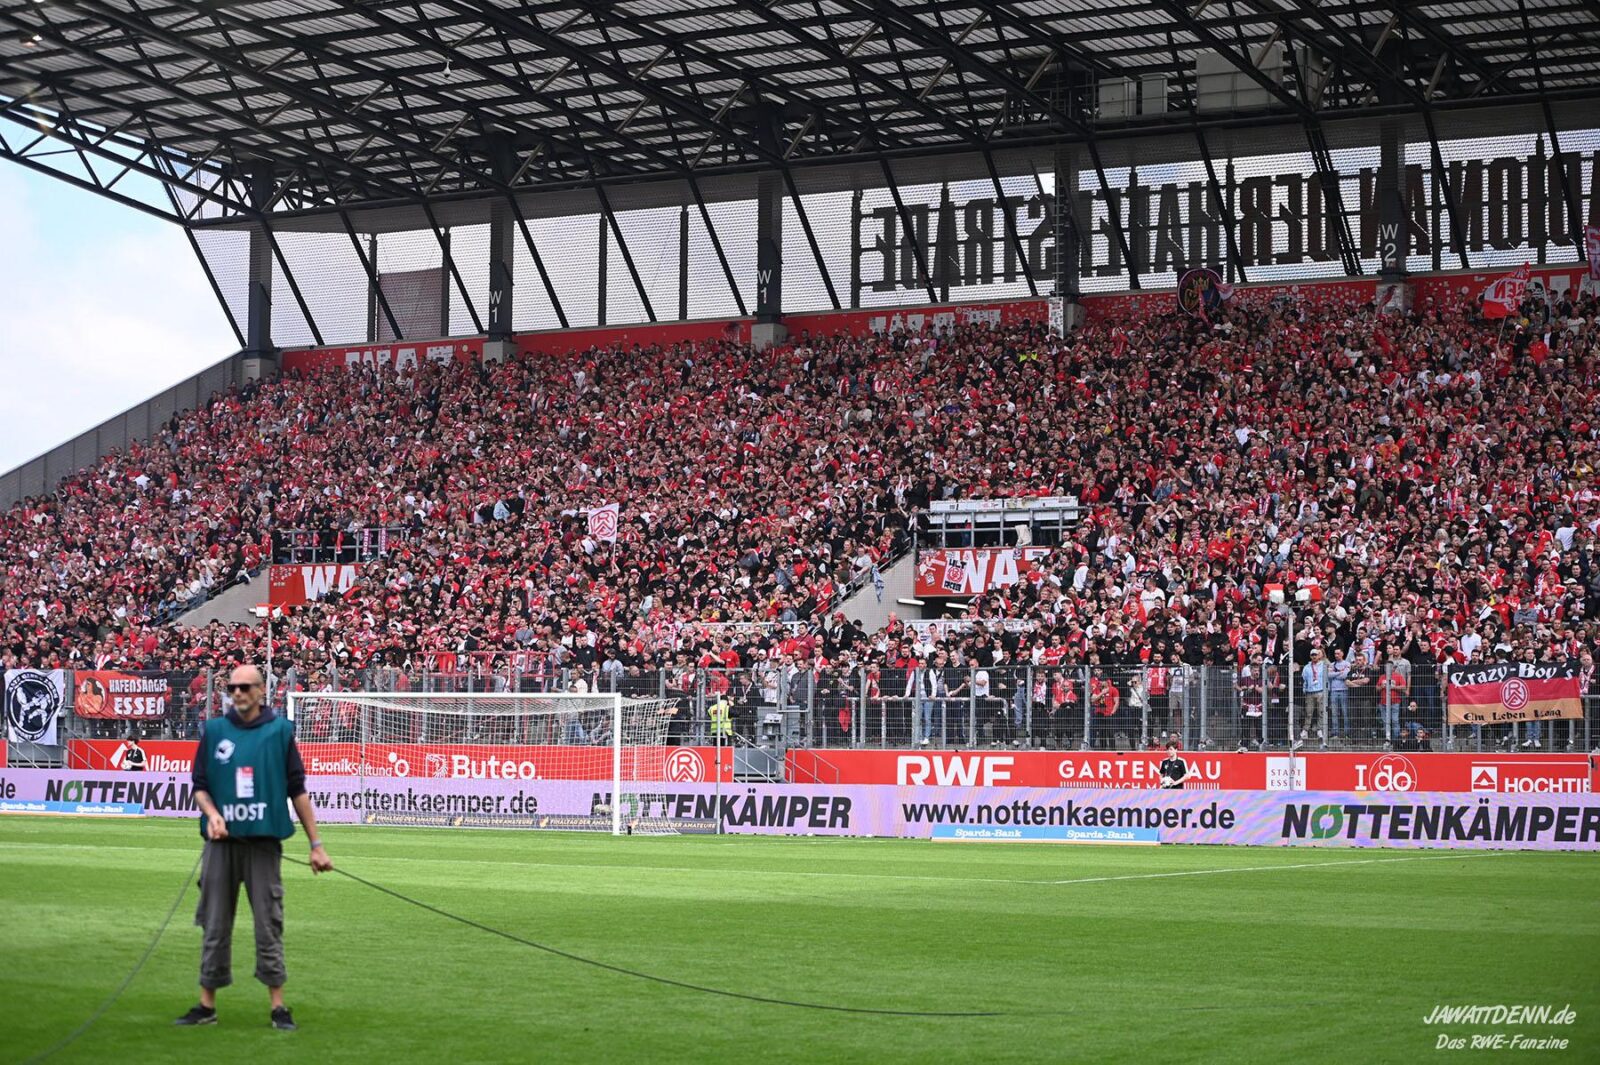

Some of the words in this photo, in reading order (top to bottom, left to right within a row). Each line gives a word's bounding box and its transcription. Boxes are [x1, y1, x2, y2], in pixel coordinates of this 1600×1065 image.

[114, 697, 165, 715] ESSEN
[1058, 760, 1222, 779] GARTENAU
[45, 777, 203, 811] NOTTENKÄM
[223, 803, 267, 821] HOST
[903, 800, 1235, 829] www.nottenkaemper.de
[1281, 798, 1600, 842] NOTTENKÄMPER
[954, 828, 1021, 839] Sparda-Bank
[1066, 830, 1135, 841] Sparda-Bank
